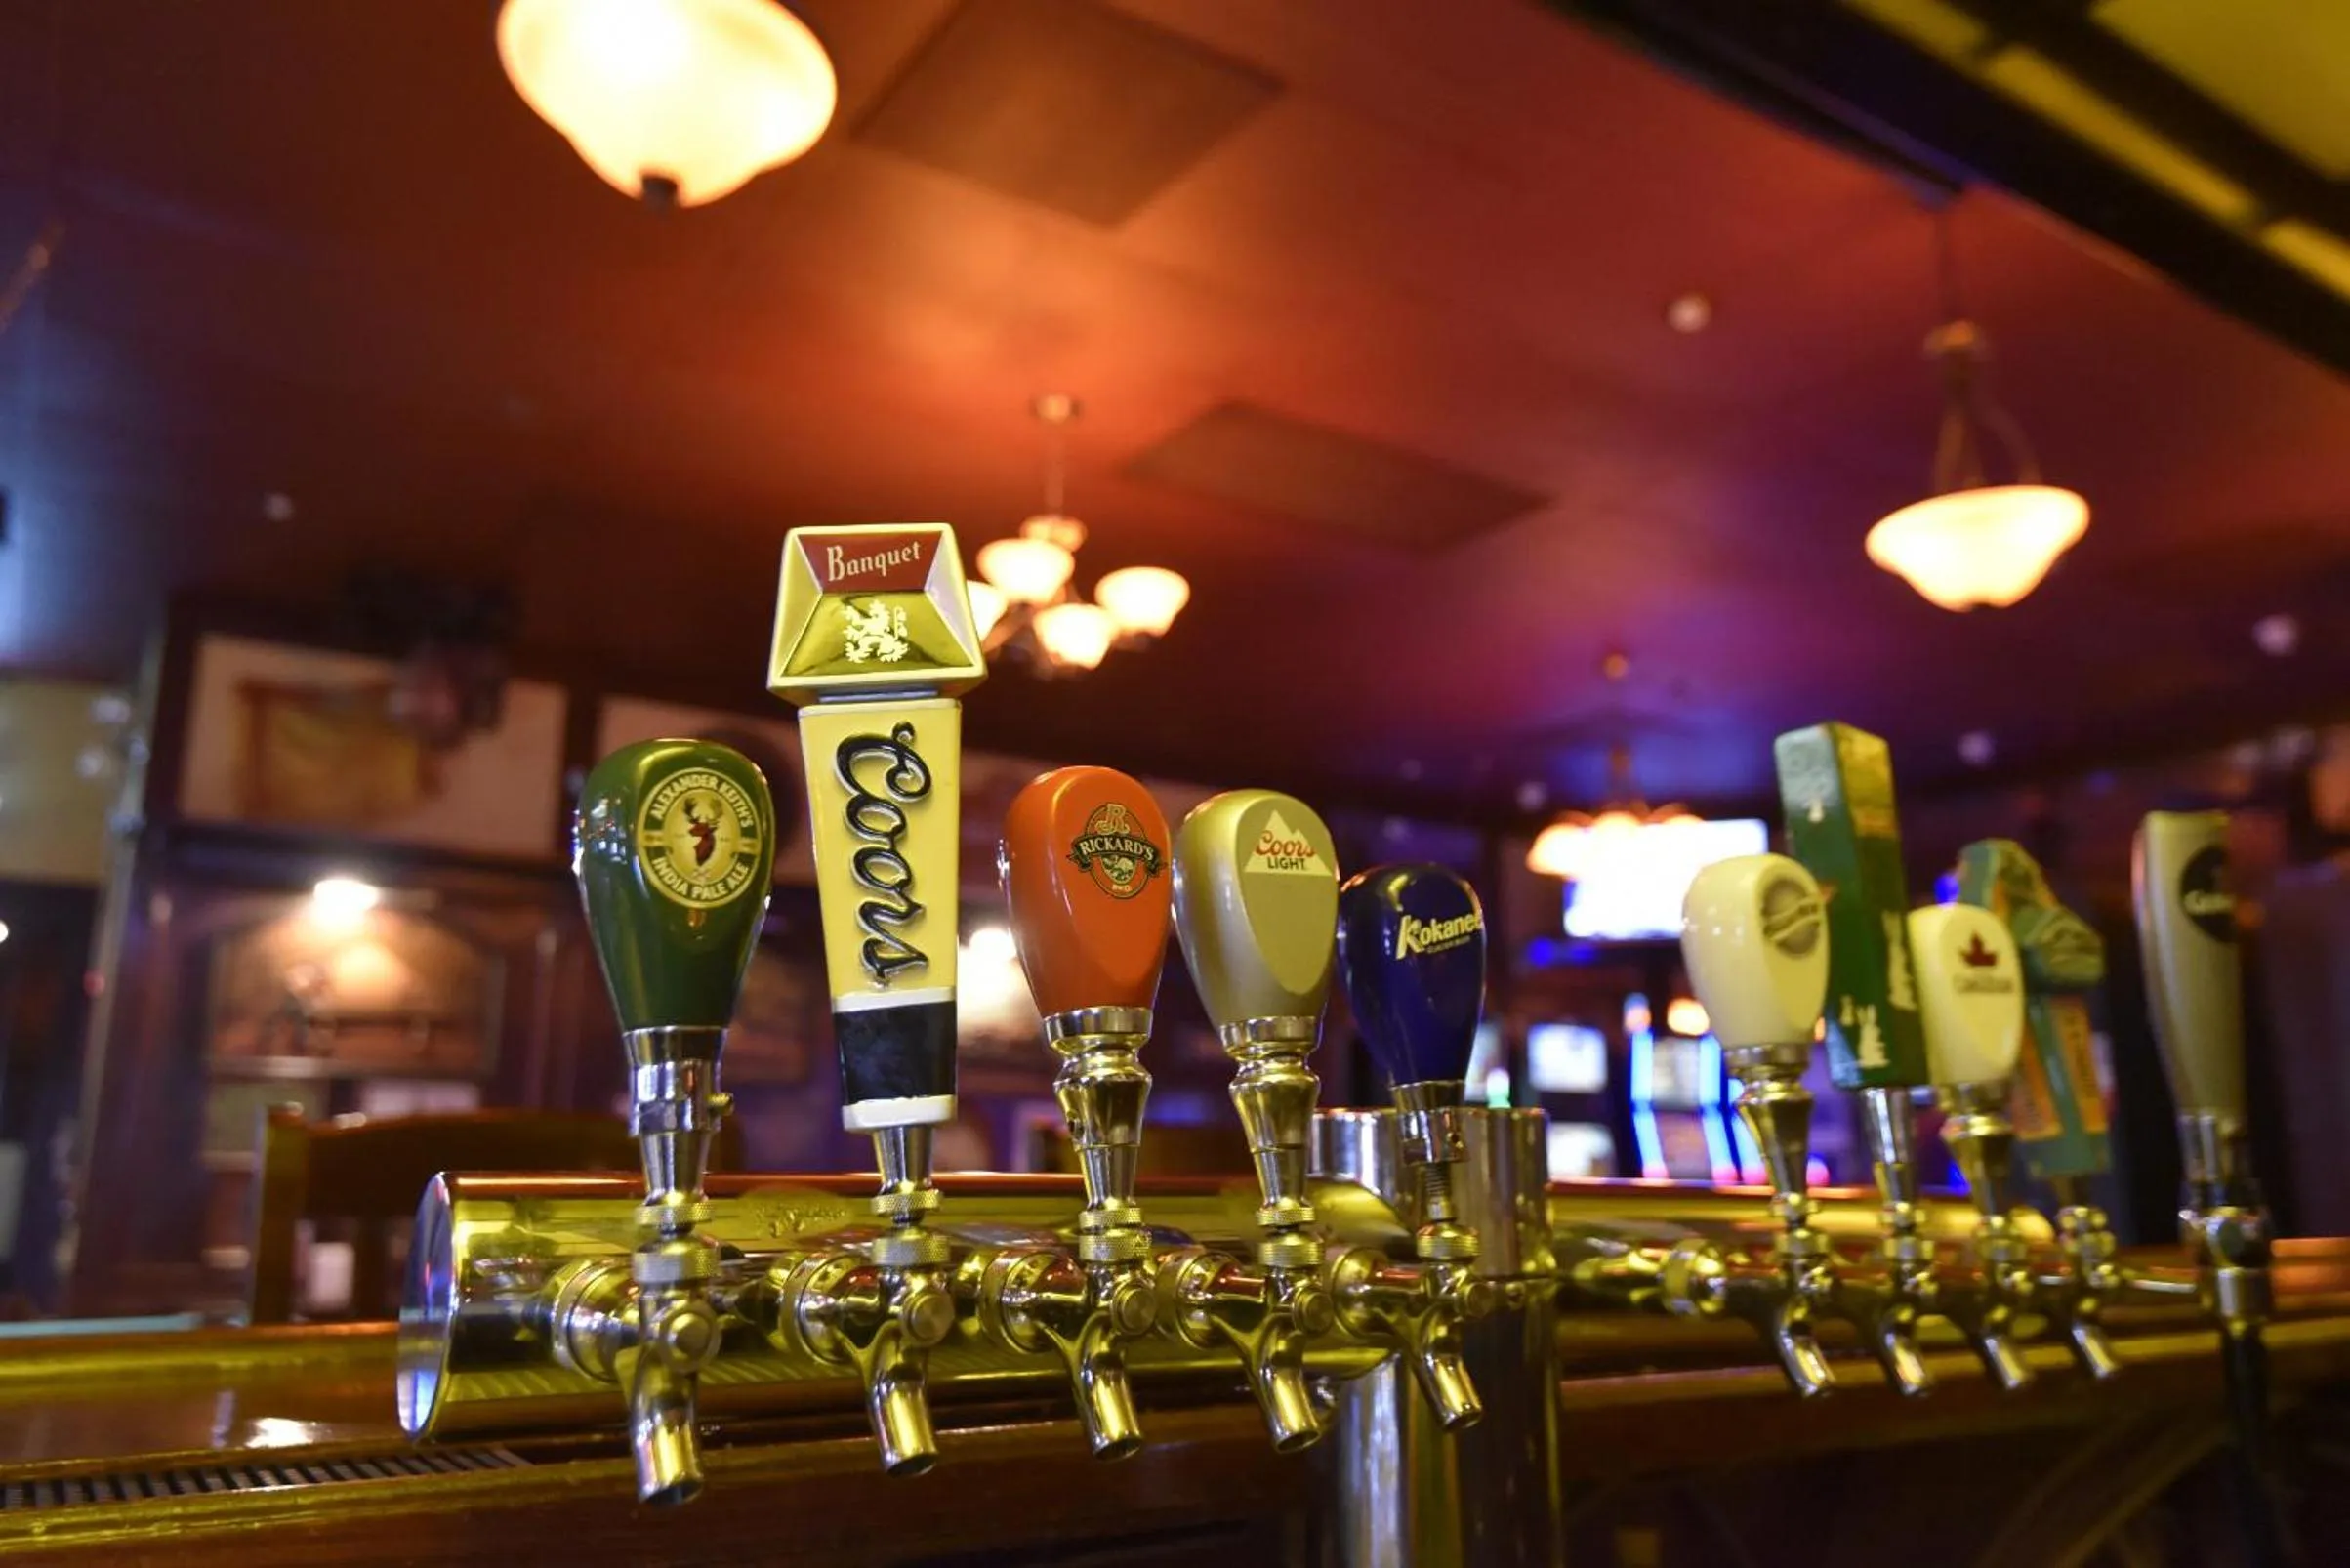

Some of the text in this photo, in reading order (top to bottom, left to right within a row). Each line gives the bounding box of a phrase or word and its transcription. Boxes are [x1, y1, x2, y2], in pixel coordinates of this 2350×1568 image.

[827, 541, 921, 582] Banquet
[650, 774, 754, 828] ALEXANDER KEITH'S
[834, 721, 932, 985] Coors
[1079, 837, 1154, 861] RICKARD'S
[1256, 830, 1316, 857] Coors
[1267, 857, 1306, 870] LIGHT
[652, 857, 749, 899] INDIA PALE ALE
